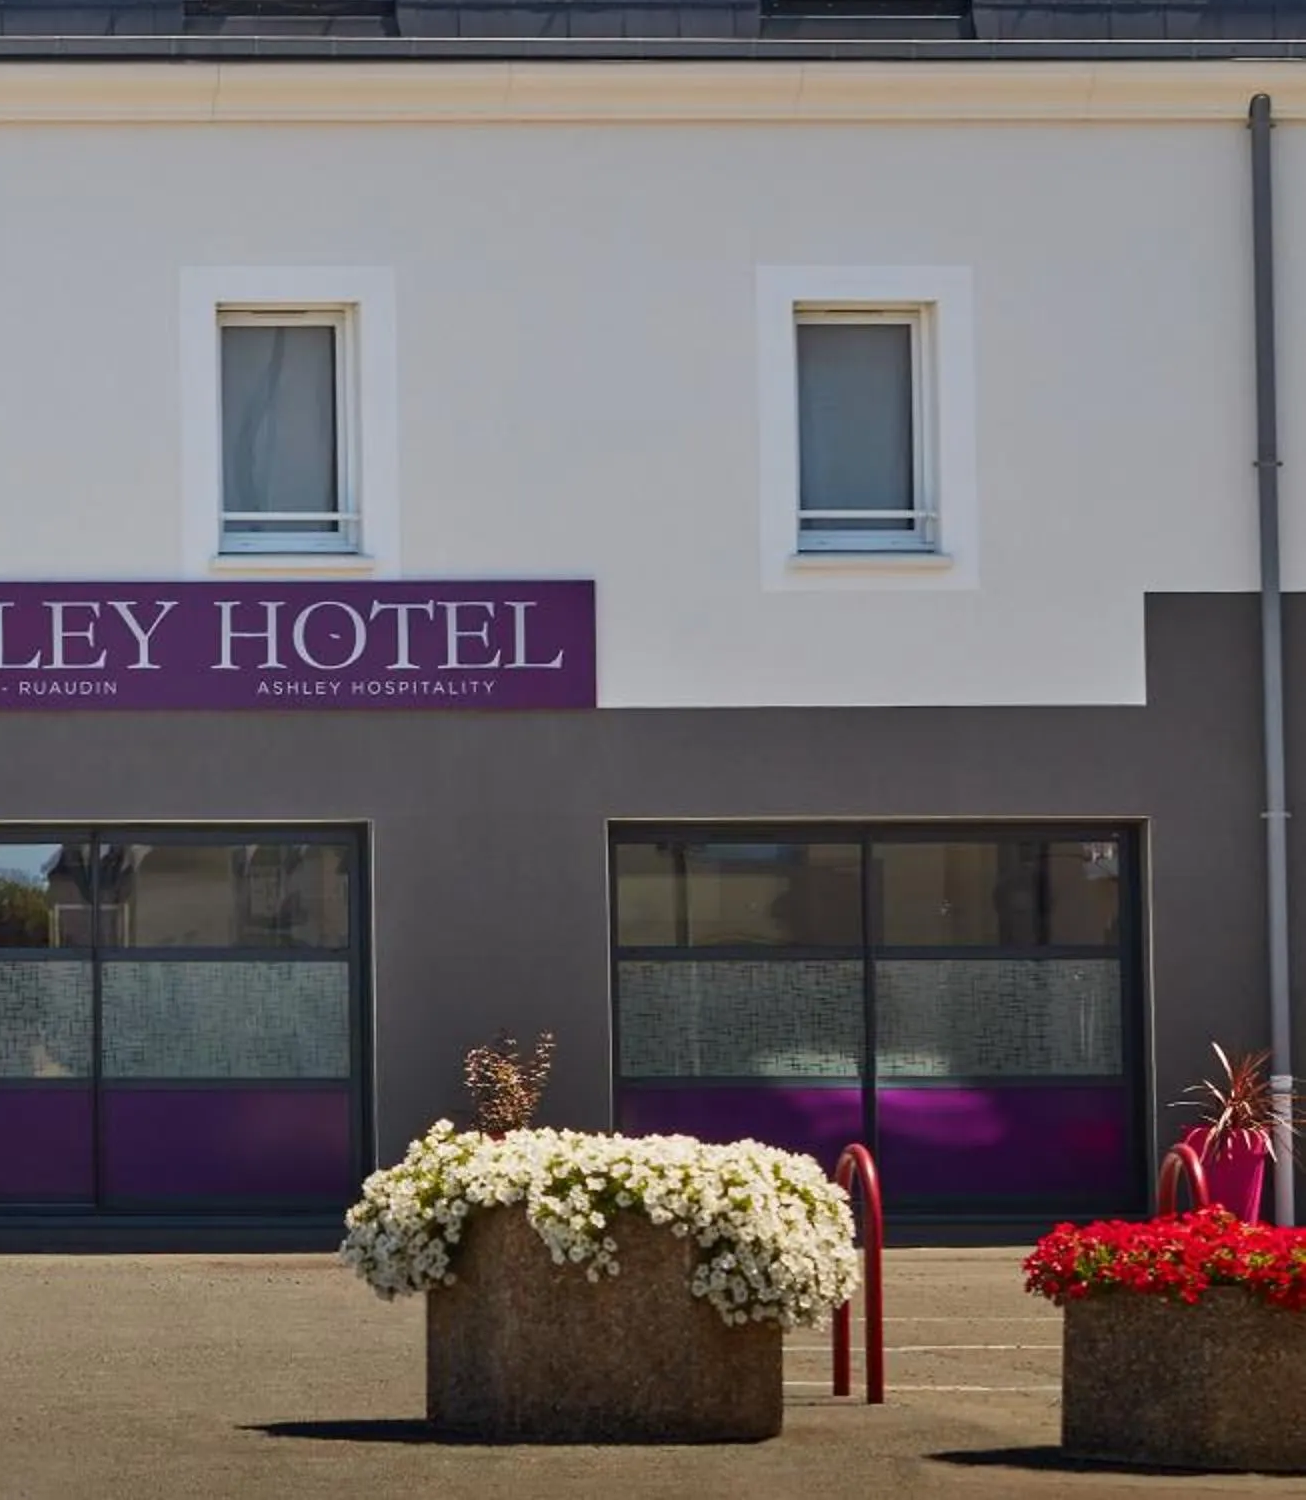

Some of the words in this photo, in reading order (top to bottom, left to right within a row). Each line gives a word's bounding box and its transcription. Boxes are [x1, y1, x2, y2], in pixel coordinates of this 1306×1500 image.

[210, 599, 564, 670] HOTEL
[19, 680, 118, 696] RUAUDIN
[257, 680, 341, 696] ASHLEY
[351, 680, 495, 696] HOSPITALITY
